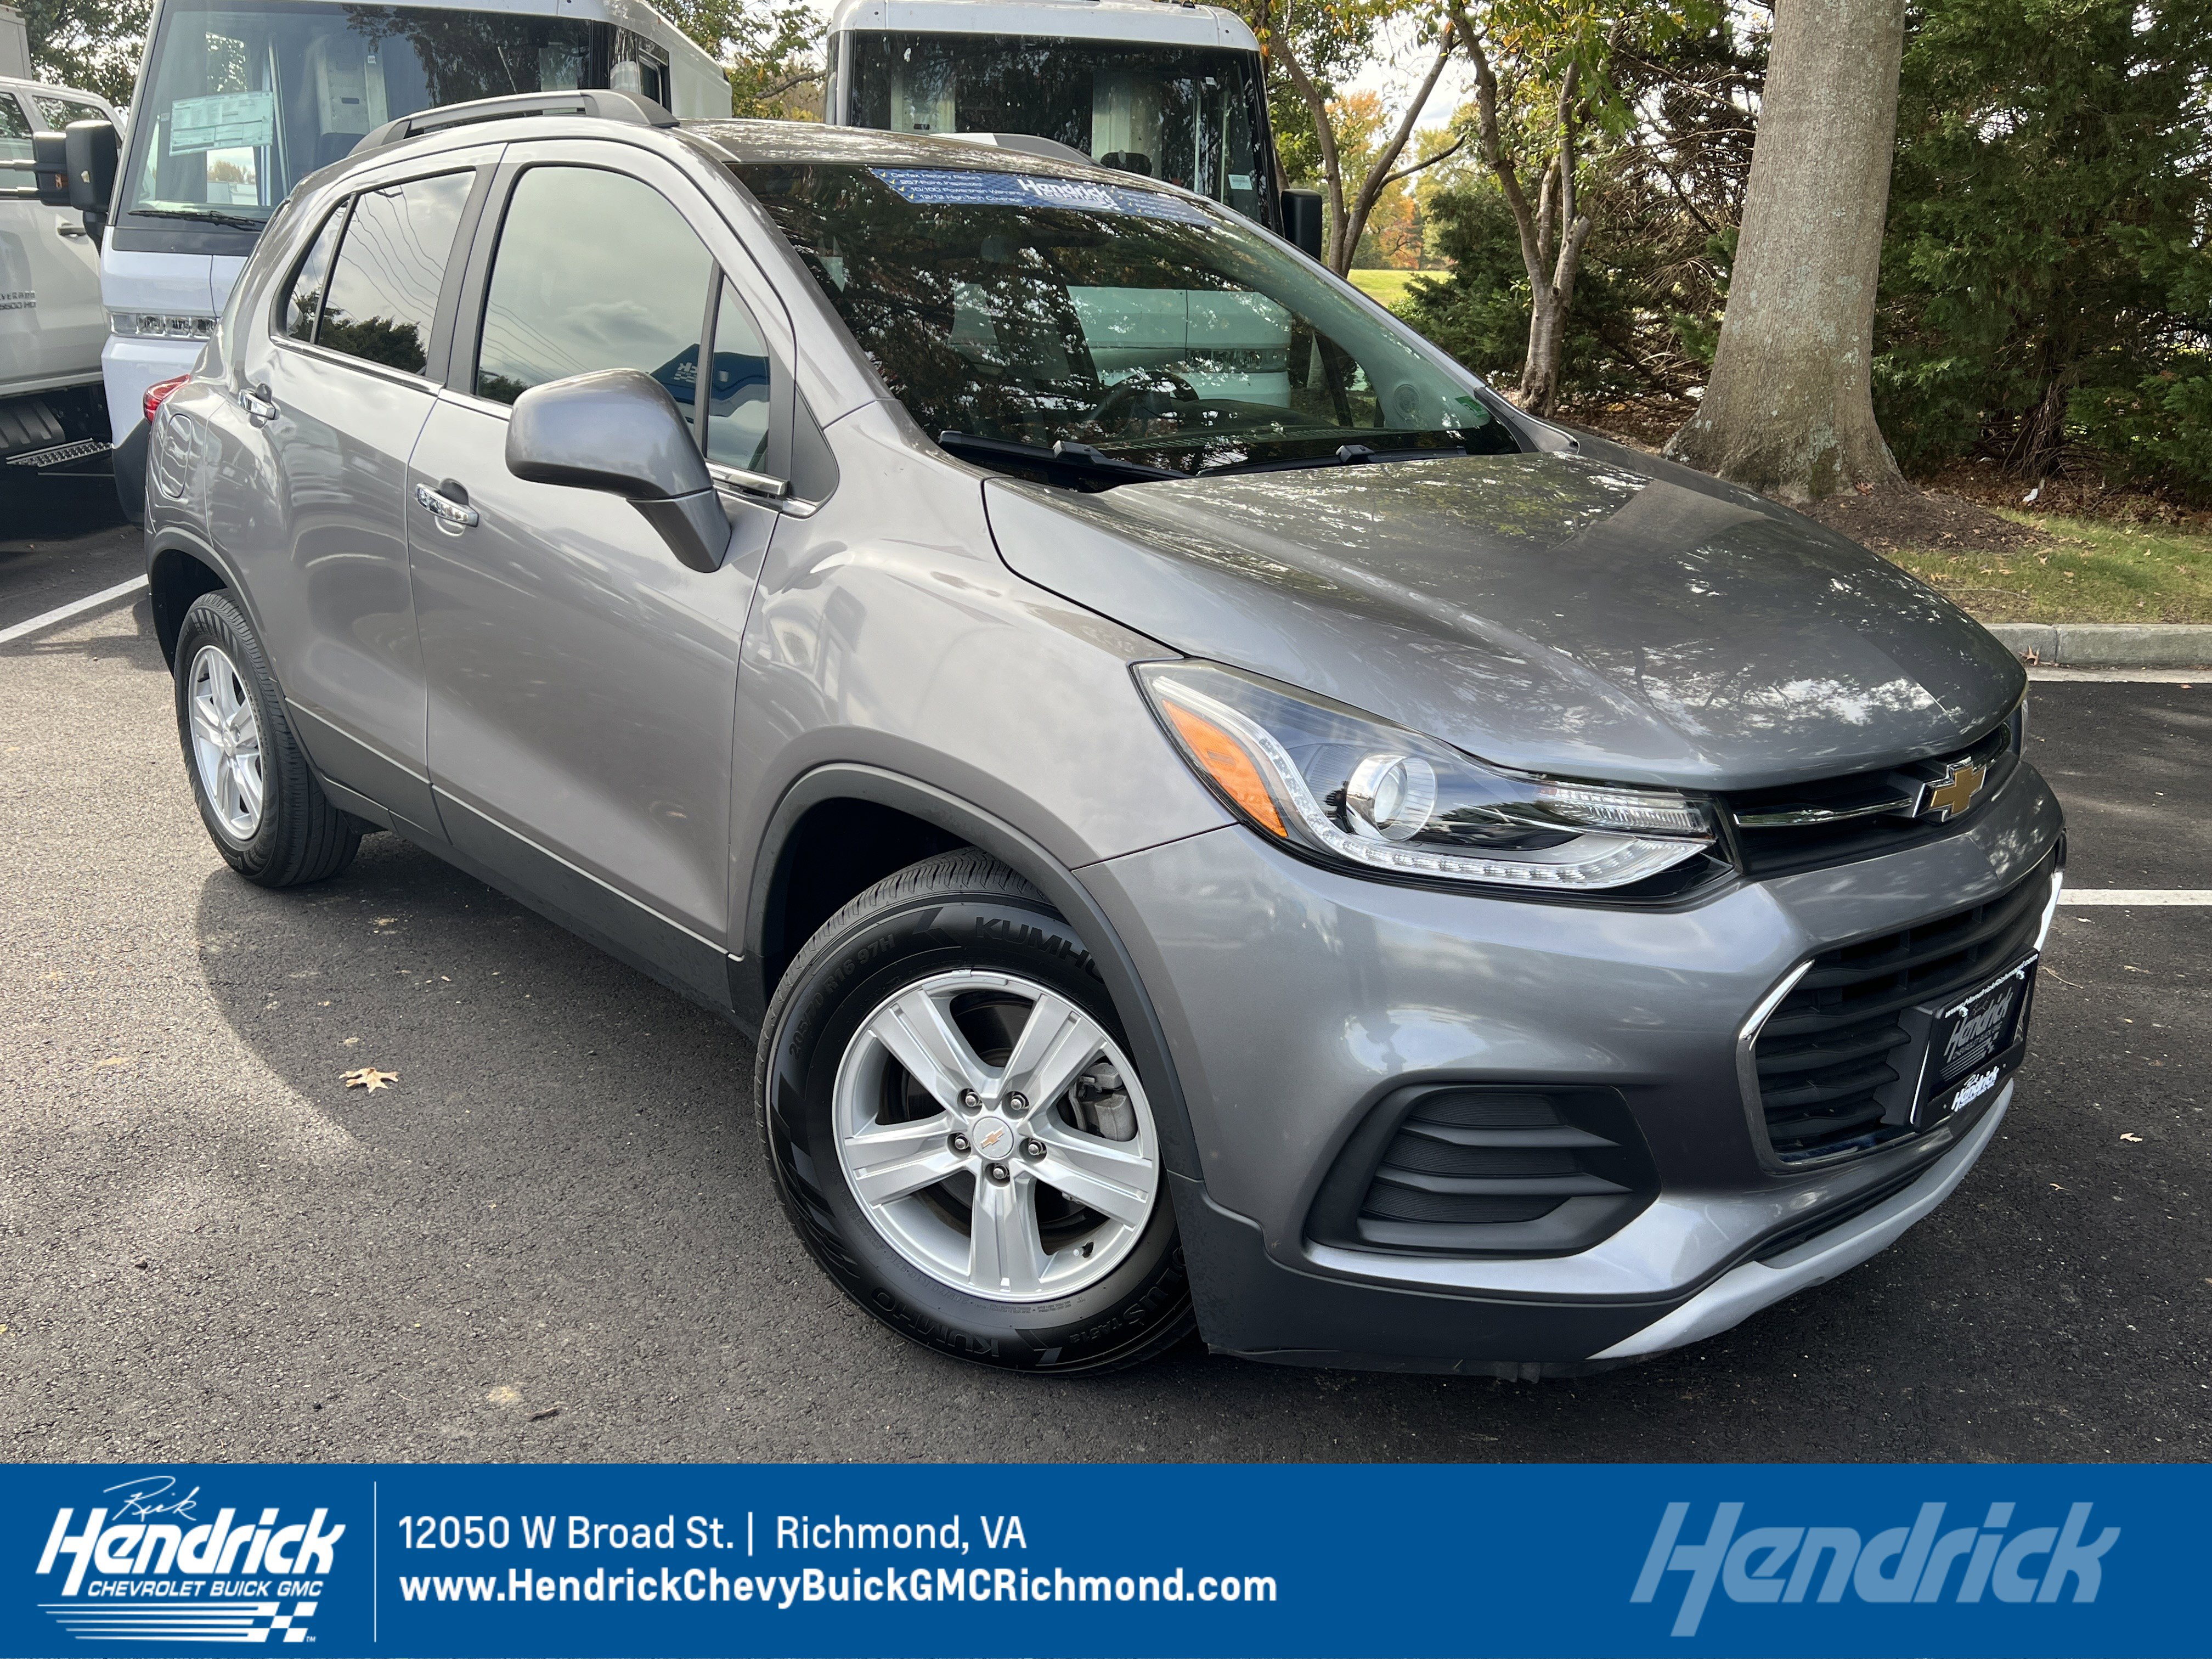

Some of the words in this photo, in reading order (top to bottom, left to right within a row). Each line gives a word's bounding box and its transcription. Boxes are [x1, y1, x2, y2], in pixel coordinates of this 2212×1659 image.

[1017, 178, 1112, 200] Hendrick
[789, 992, 823, 1060] 205/70
[823, 960, 856, 995] R16
[857, 934, 896, 964] 97H
[1943, 986, 2013, 1064] Hendrick
[1951, 1065, 2000, 1112] Hendrick
[871, 1286, 999, 1357] KUMHO
